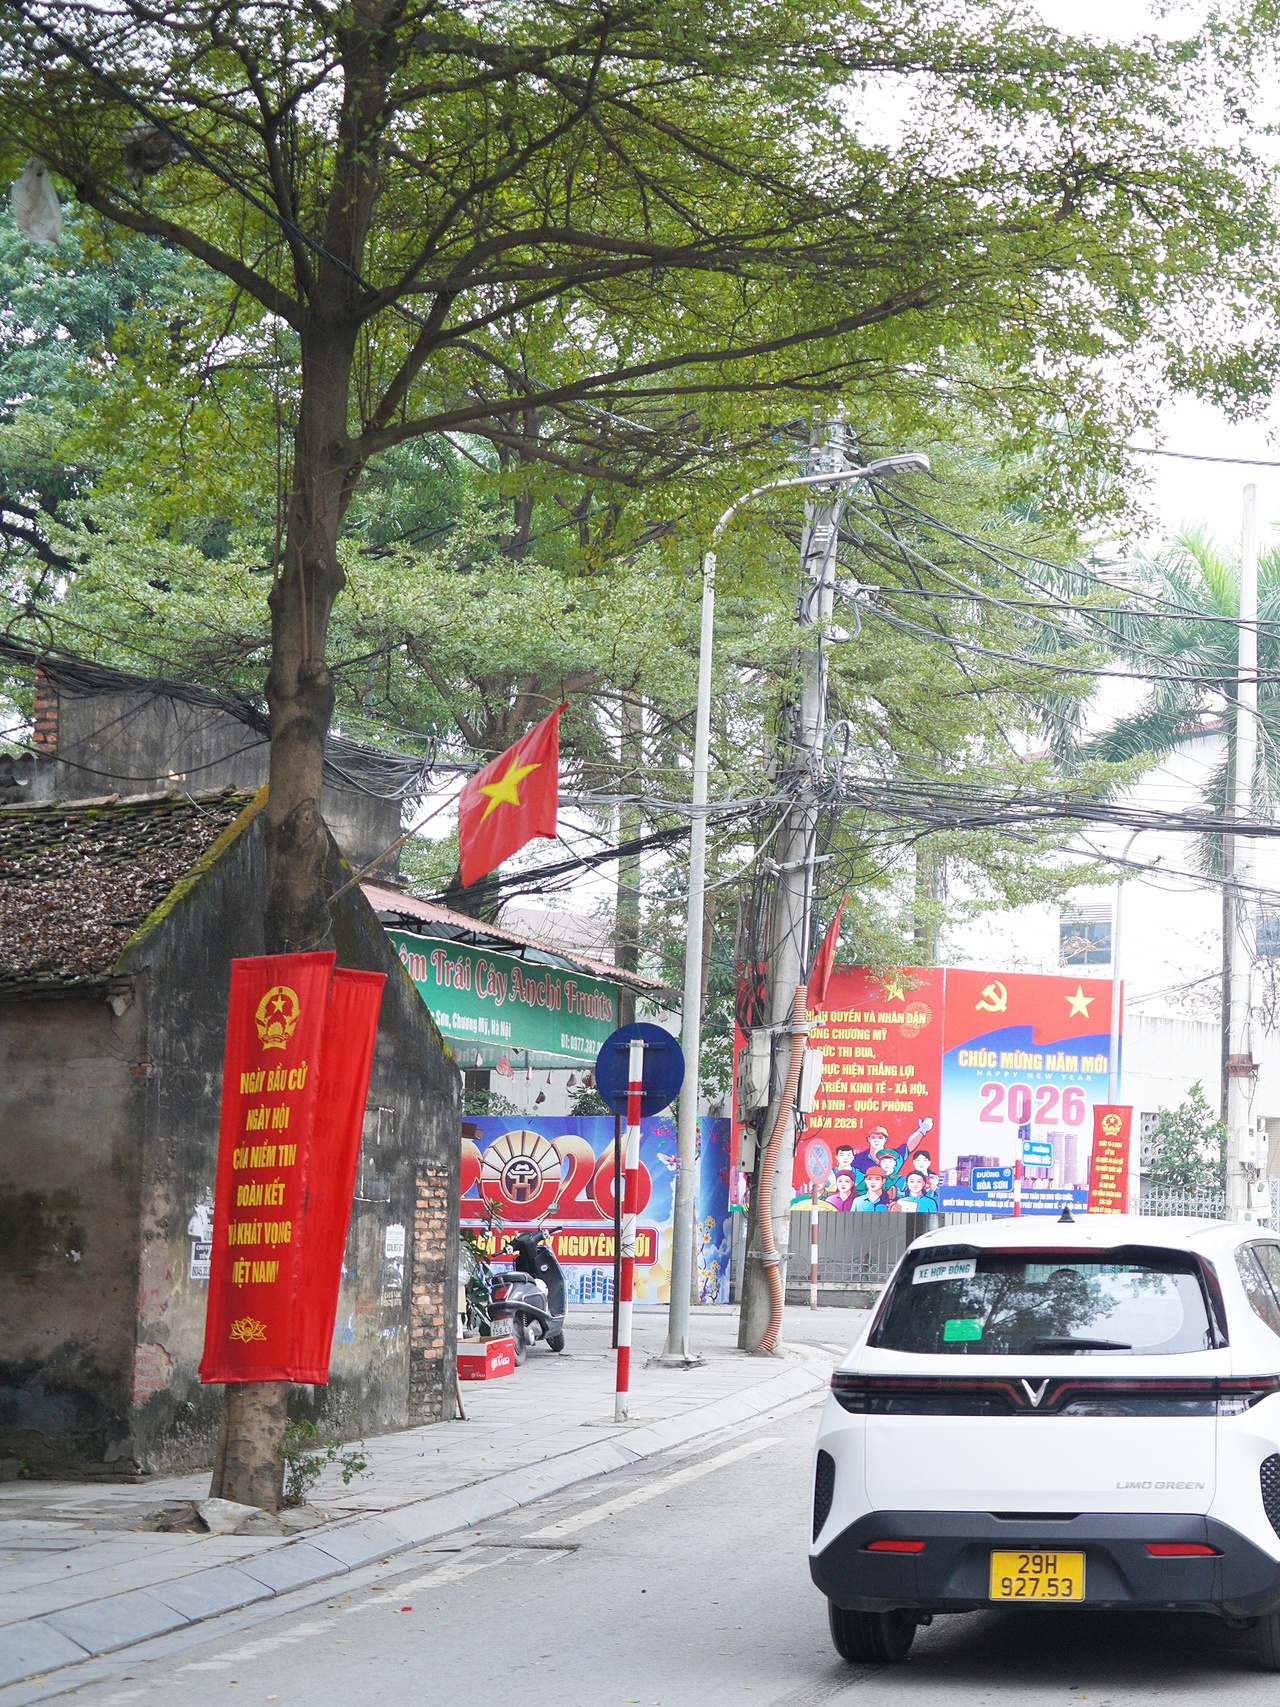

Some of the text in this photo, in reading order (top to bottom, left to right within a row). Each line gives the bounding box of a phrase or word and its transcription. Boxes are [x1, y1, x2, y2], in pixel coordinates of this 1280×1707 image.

[430, 948, 471, 991] Trái
[475, 958, 508, 1006] Cây
[508, 966, 561, 1011] Anchi
[564, 980, 613, 1022] Fruits
[452, 1012, 478, 1034] Chương
[491, 1020, 500, 1036] Hà
[500, 1021, 512, 1040] Nội
[806, 1008, 926, 1024] HÍNH QUYỀN VÀ NHÂN DÂN
[832, 1028, 870, 1040] CHƯƠNG
[872, 1028, 888, 1040] MỸ
[838, 1046, 852, 1057] THI
[854, 1046, 876, 1059] ĐUA,
[958, 1048, 1108, 1074] CHÚC MỪNG NĂM MỚI
[240, 1060, 308, 1094] NGÀY BẦU CỬ
[822, 1062, 914, 1078] HỰC HIỆN THẮNG LỢI
[976, 1070, 1018, 1078] HAPPY
[1028, 1072, 1053, 1080] NEW
[821, 1078, 848, 1092] TRIỂN
[850, 1082, 872, 1093] KINH
[875, 1080, 887, 1094] TẾ
[894, 1081, 908, 1094] XÃ
[910, 1081, 928, 1096] HỘI,
[814, 1100, 820, 1110] N
[822, 1100, 846, 1110] NINH
[854, 1097, 880, 1112] QUỐC
[882, 1098, 914, 1112] PHÒNG
[979, 1082, 1086, 1127] 2026
[246, 1102, 290, 1134] NGÀY HỘI
[810, 1115, 832, 1128] NĂM
[834, 1118, 858, 1129] 2026
[232, 1138, 297, 1170] CỦA NIỀM TIN
[976, 1170, 1000, 1178] ĐƯỜNG
[236, 1176, 286, 1206] ĐOÀN KẾT
[976, 1180, 1008, 1190] HÒA SƠN
[237, 1218, 262, 1245] KHÁT
[264, 1221, 292, 1249] VỌNG
[558, 1233, 615, 1256] NGUYÊN
[634, 1233, 650, 1256] ỚI
[232, 1256, 252, 1288] IỆT
[919, 1268, 928, 1278] XE
[930, 1266, 946, 1278] HỢP
[1116, 1481, 1206, 1490] LIMO GREEN
[1018, 1554, 1057, 1574] 29H
[1001, 1577, 1073, 1597] 927.53
